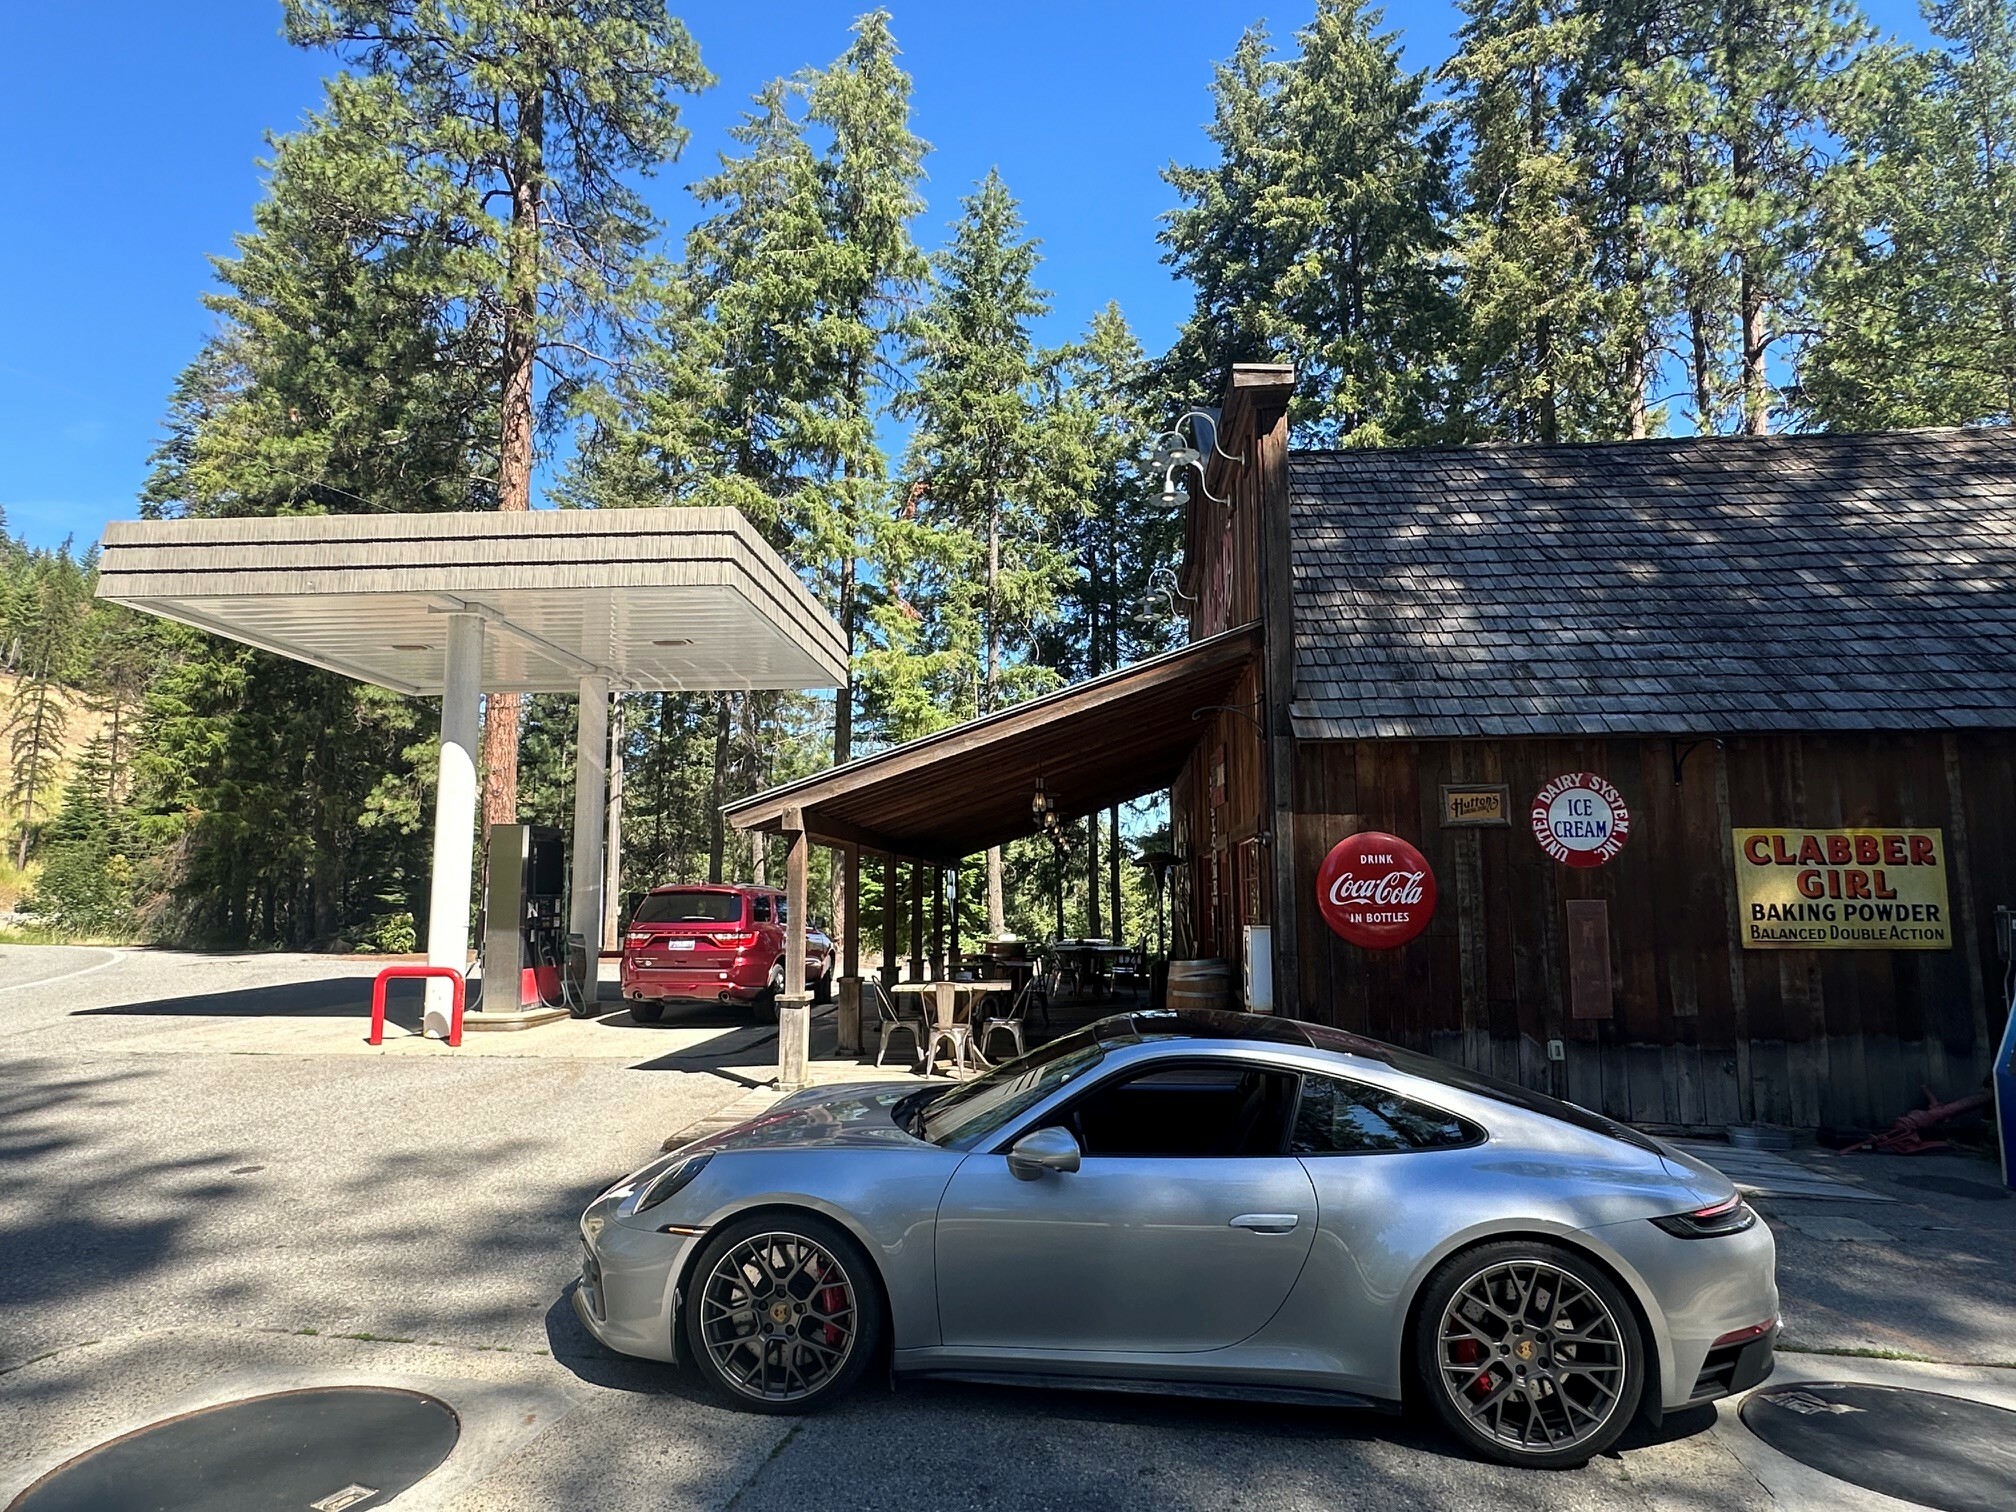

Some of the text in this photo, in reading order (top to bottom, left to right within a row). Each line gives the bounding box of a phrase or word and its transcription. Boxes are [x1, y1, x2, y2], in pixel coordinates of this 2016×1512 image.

[1537, 773, 1583, 804] DAIRY
[1567, 799, 1592, 816] ICE
[1532, 808, 1569, 862] UNITED
[1554, 821, 1607, 838] CREAM
[1360, 854, 1394, 864] DRINK
[1593, 837, 1622, 861] INC.
[1743, 835, 1937, 866] CLABBER
[1329, 871, 1426, 906] Coca-Cola
[1797, 869, 1897, 900] GIRL
[1350, 912, 1410, 923] IN BOTTLES
[1751, 903, 1941, 922] BAKING POWDER
[1750, 924, 1945, 940] BALANCED DOUBLE ACTION
